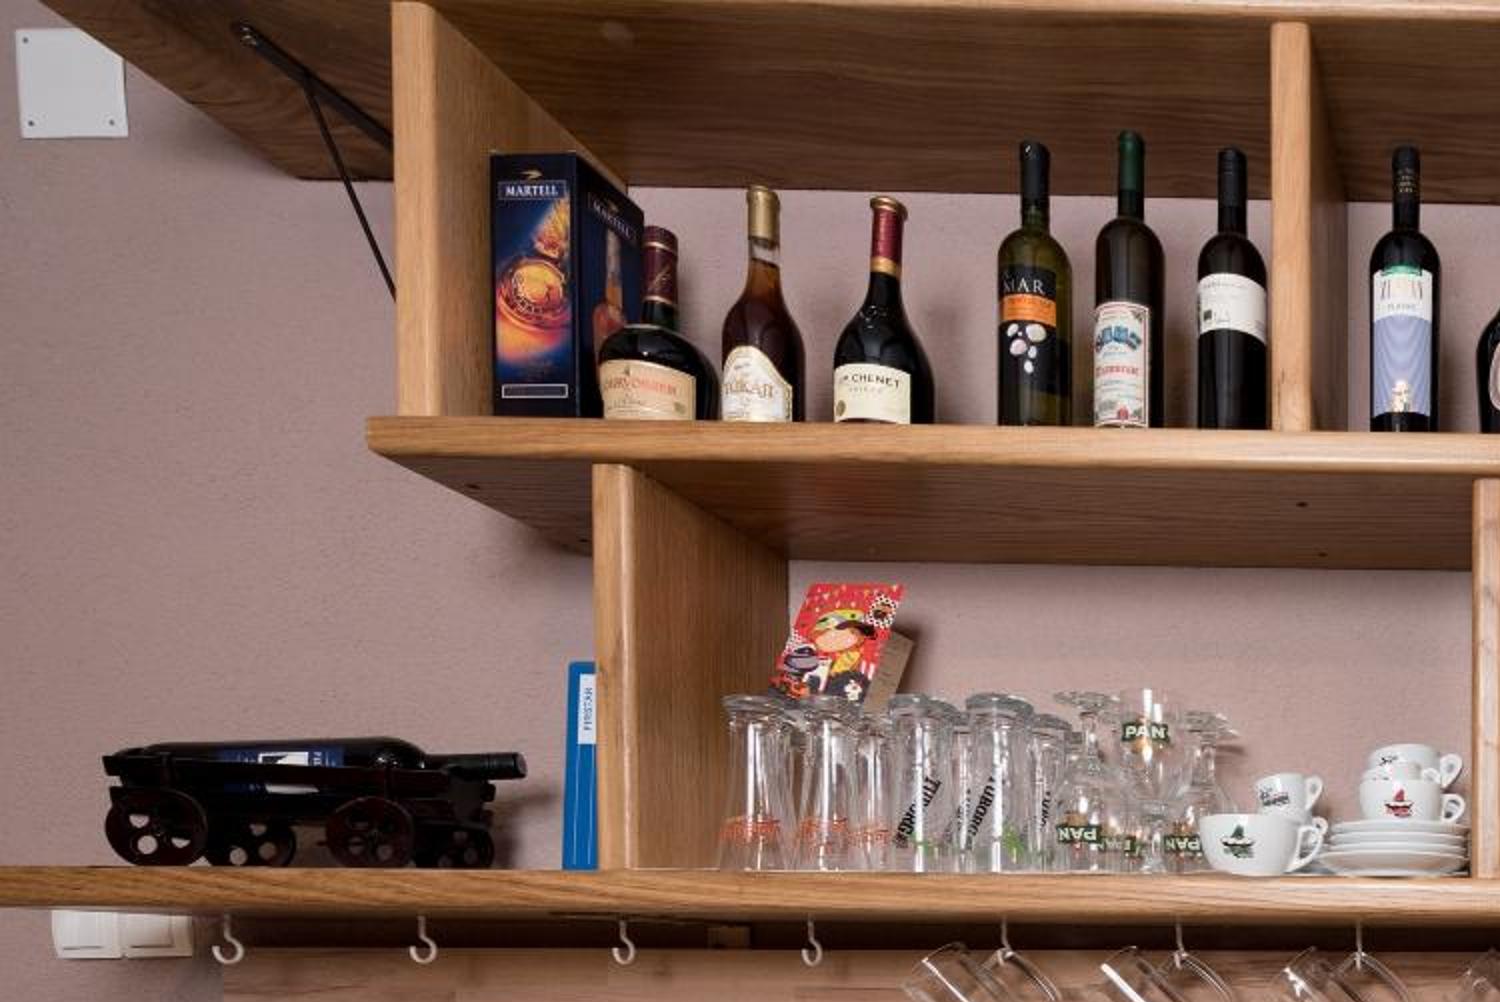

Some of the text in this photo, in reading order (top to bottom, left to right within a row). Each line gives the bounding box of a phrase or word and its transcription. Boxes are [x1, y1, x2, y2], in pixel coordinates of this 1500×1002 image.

[504, 185, 560, 198] MARTELL
[851, 373, 899, 390] CHENET
[1124, 725, 1167, 740] PAN
